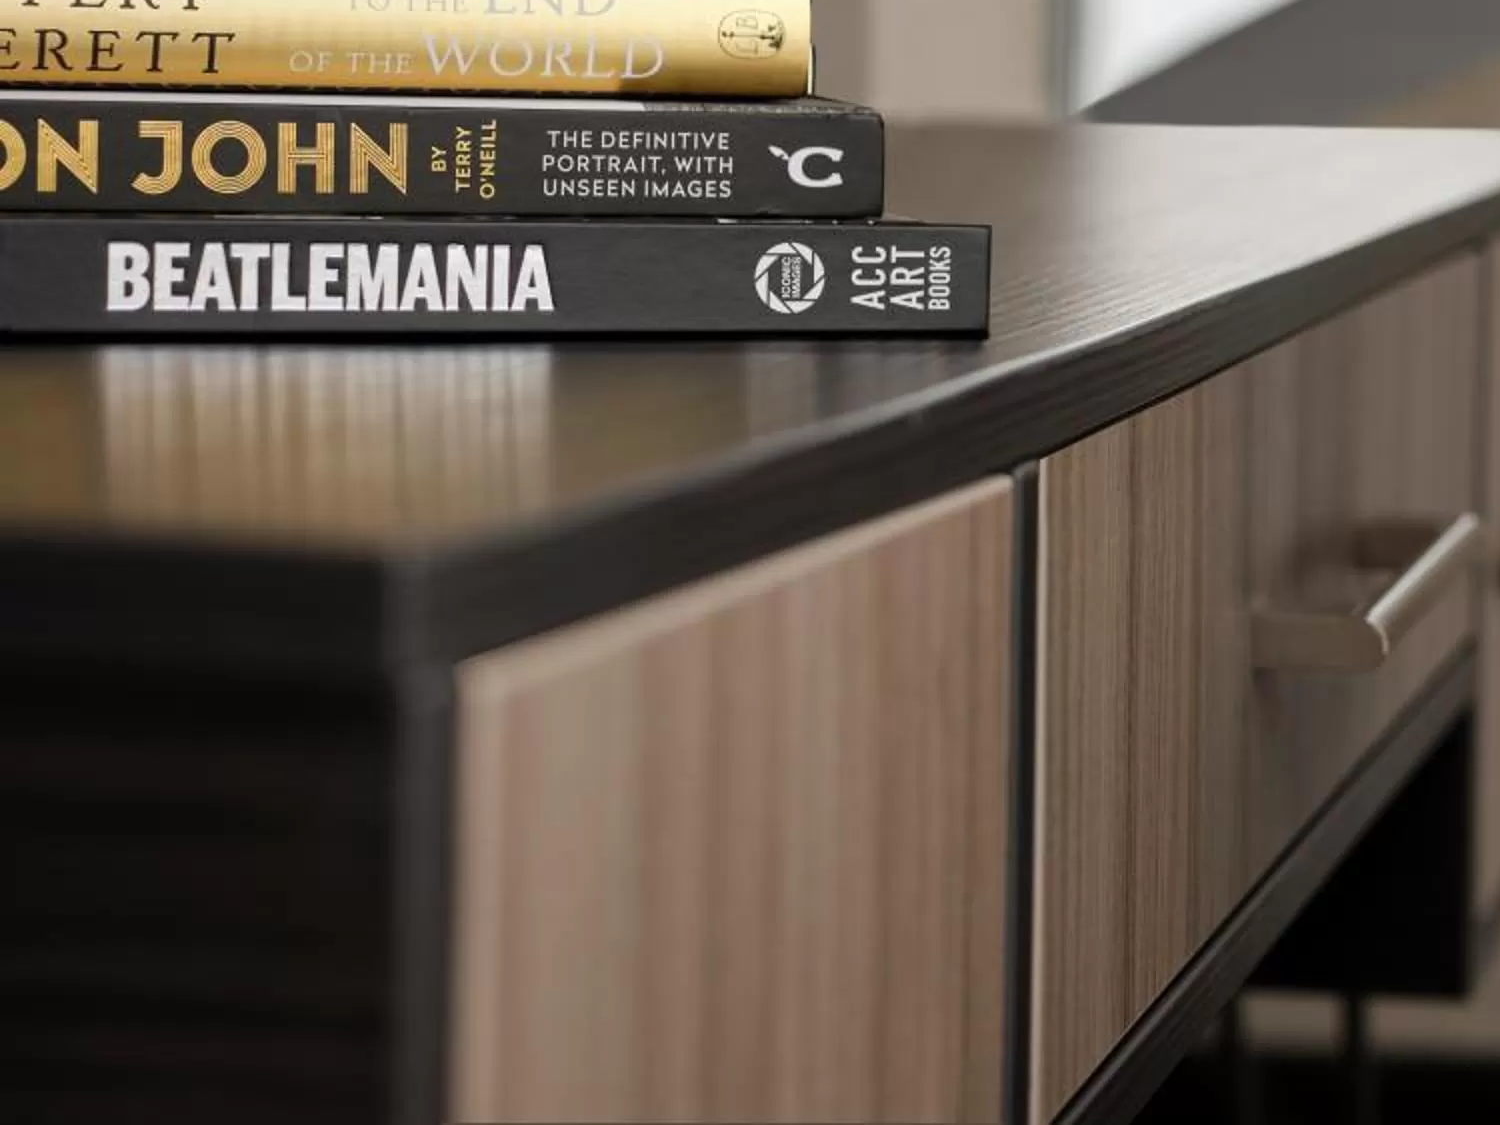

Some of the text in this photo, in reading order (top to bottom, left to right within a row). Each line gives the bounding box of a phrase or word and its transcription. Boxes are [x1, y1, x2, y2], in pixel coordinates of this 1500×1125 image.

[289, 33, 664, 79] OF THE WORLD
[131, 119, 408, 196] JOHN
[431, 146, 447, 172] BY
[455, 126, 473, 193] TERRY
[479, 119, 497, 199] O'NEILL
[542, 155, 733, 175] PORTRAIT, WITH
[547, 130, 730, 150] THE DEFINITIVE
[543, 179, 732, 198] UNSEEN IMAGES
[106, 241, 555, 312] BEATLEMANIA
[781, 256, 791, 298] ICONIC
[850, 246, 887, 310] ACC
[889, 245, 926, 311] ART
[928, 246, 952, 310] BOOKS
